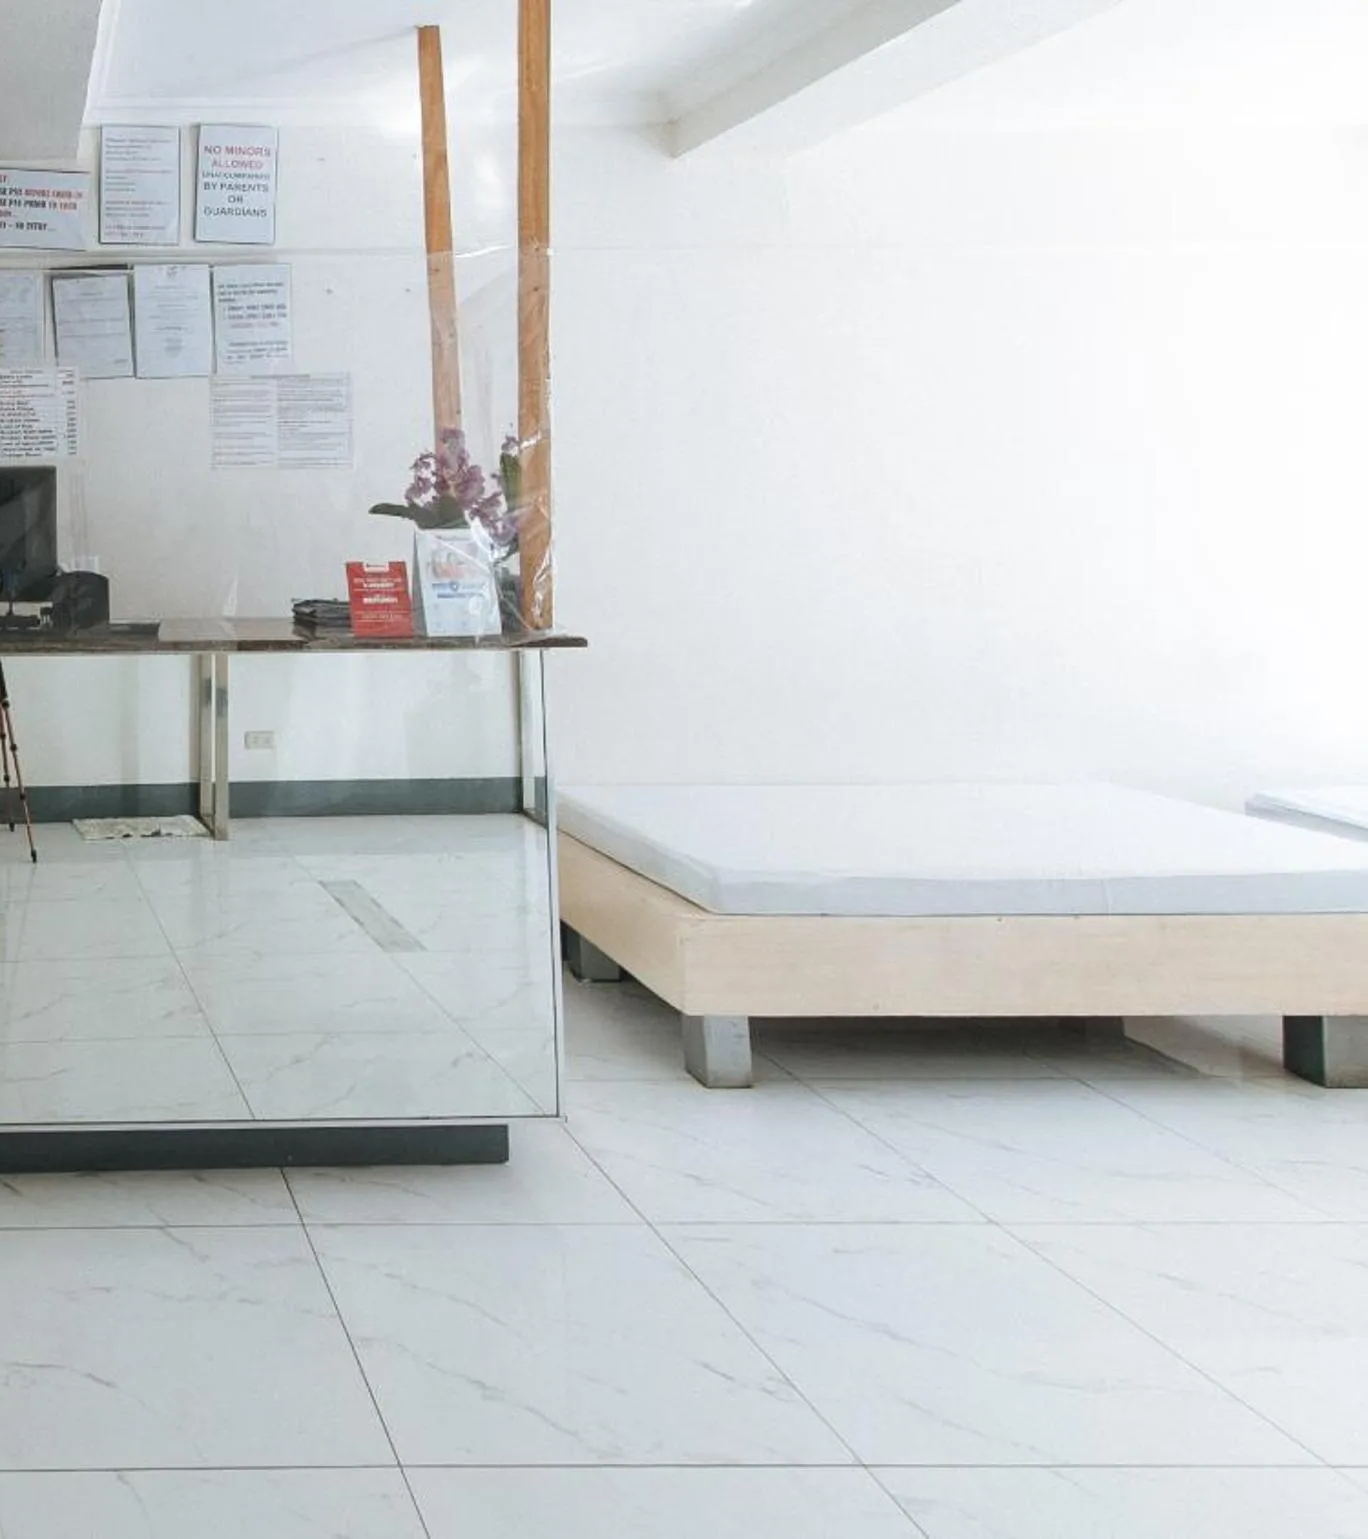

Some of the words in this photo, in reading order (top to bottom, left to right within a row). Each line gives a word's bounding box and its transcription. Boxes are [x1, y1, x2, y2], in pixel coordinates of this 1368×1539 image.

[203, 145, 222, 154] NO
[225, 146, 271, 157] MINORS
[211, 159, 264, 170] ALLOWED
[203, 182, 218, 191] BY
[220, 182, 269, 193] PARENTS
[227, 194, 244, 204] OR
[203, 206, 268, 218] GUARDIANS
